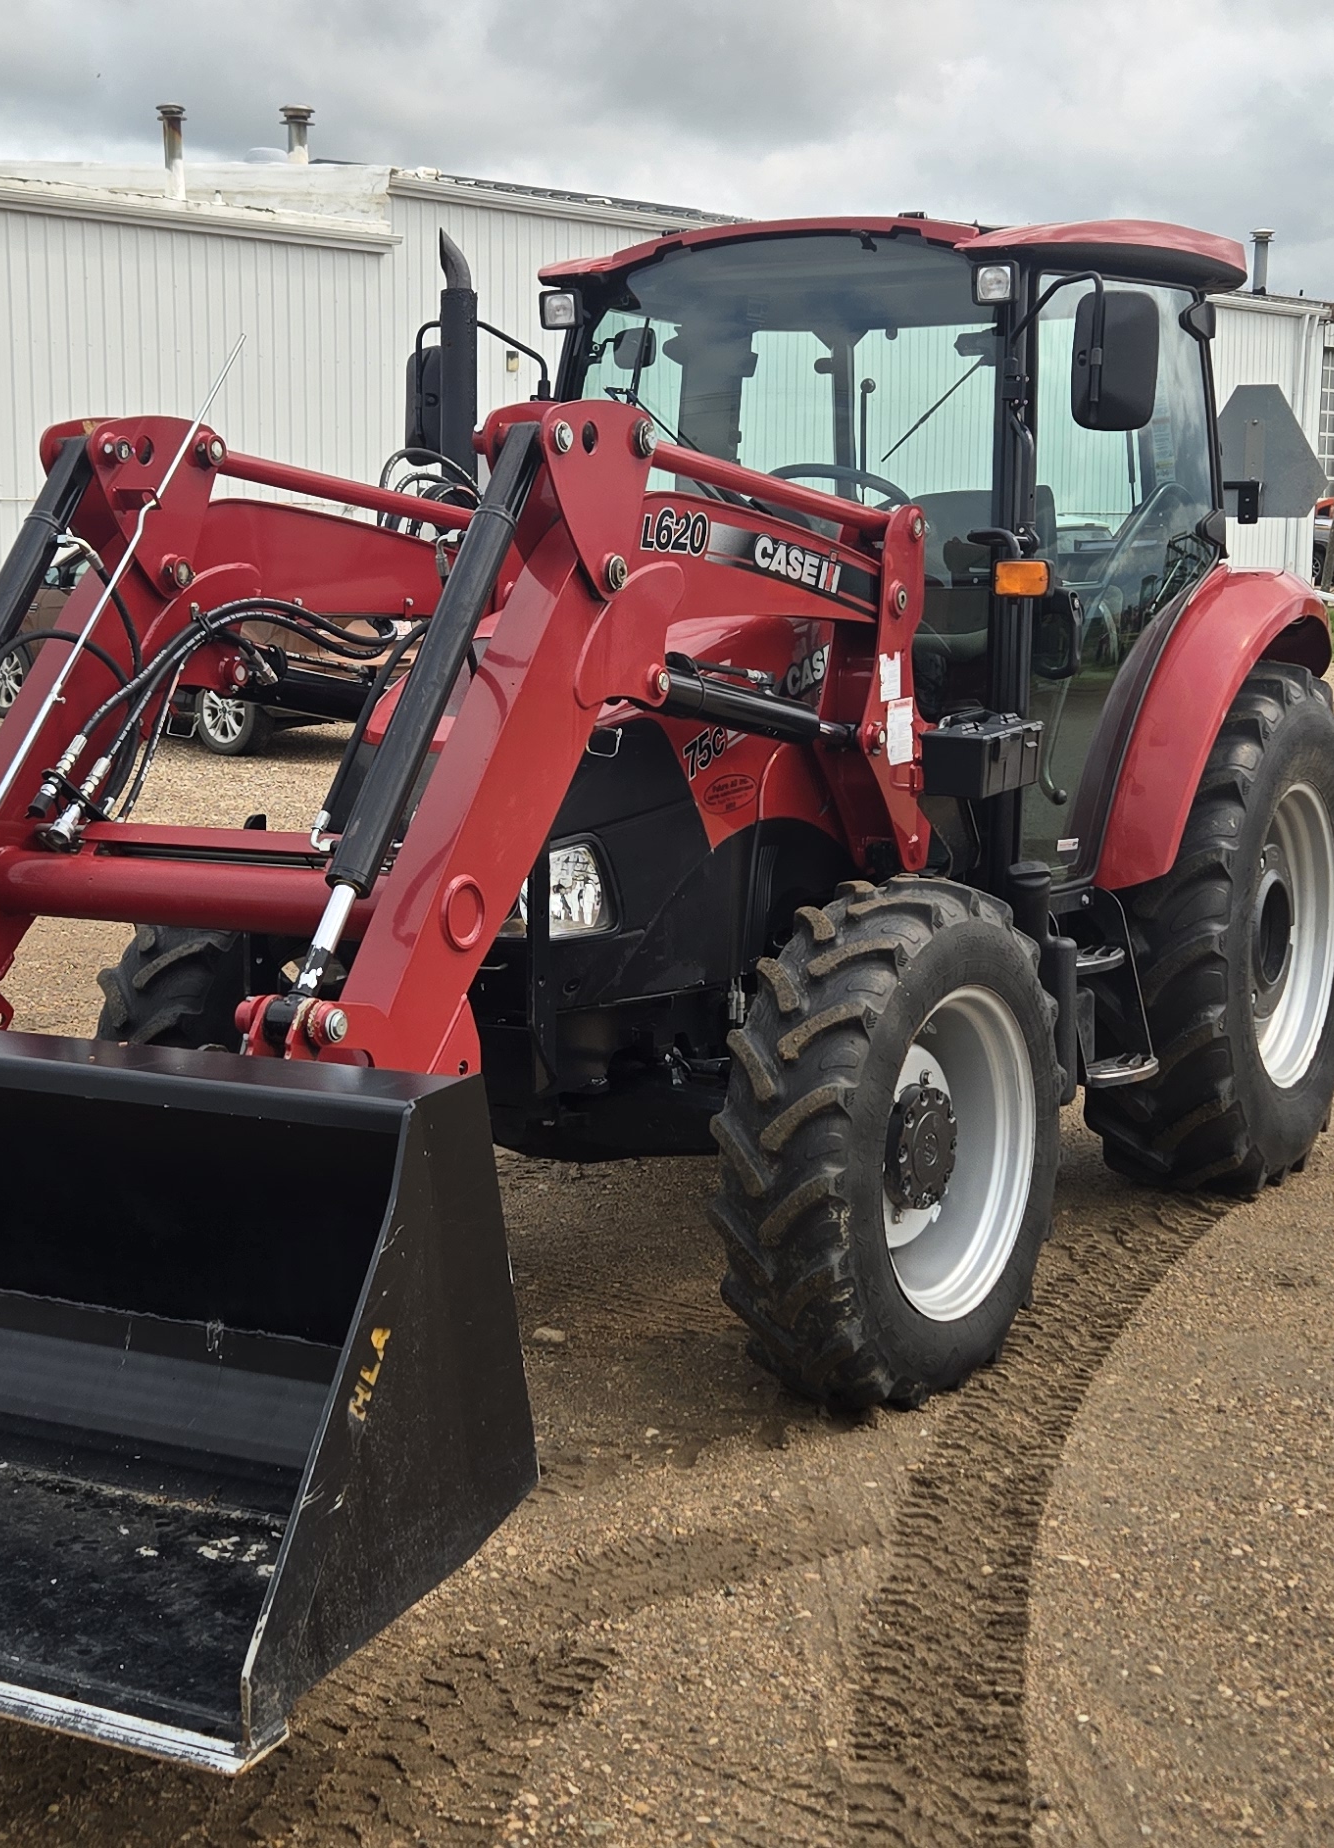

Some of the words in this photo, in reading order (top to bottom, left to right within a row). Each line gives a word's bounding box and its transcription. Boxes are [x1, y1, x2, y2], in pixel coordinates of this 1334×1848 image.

[640, 507, 708, 557] L620
[754, 534, 819, 585] CASE
[683, 726, 726, 781] 75C
